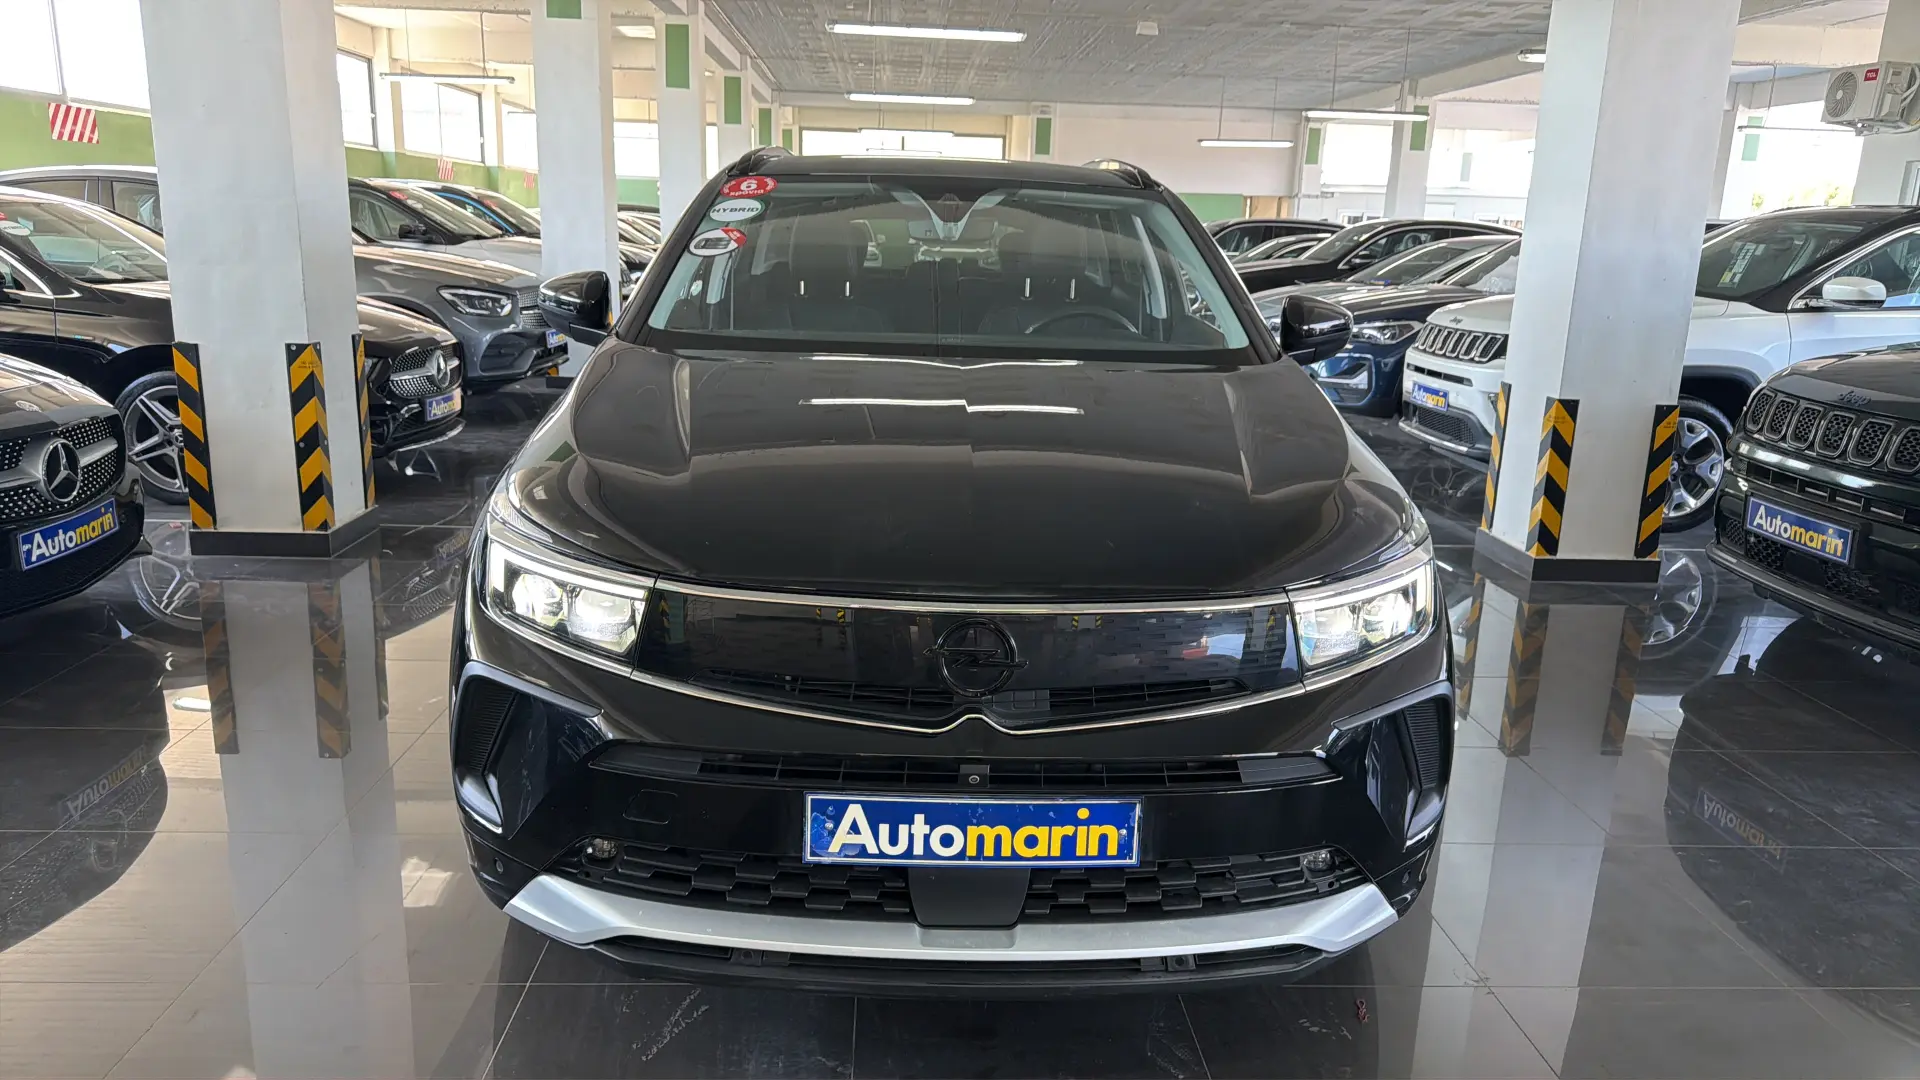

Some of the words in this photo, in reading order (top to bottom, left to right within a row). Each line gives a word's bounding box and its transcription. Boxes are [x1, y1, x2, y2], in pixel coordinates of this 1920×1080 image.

[740, 180, 758, 191] 6
[1412, 384, 1446, 408] Automarin
[31, 507, 114, 562] Automarin
[1753, 505, 1844, 556] Automarin
[828, 803, 1118, 857] Automarin
